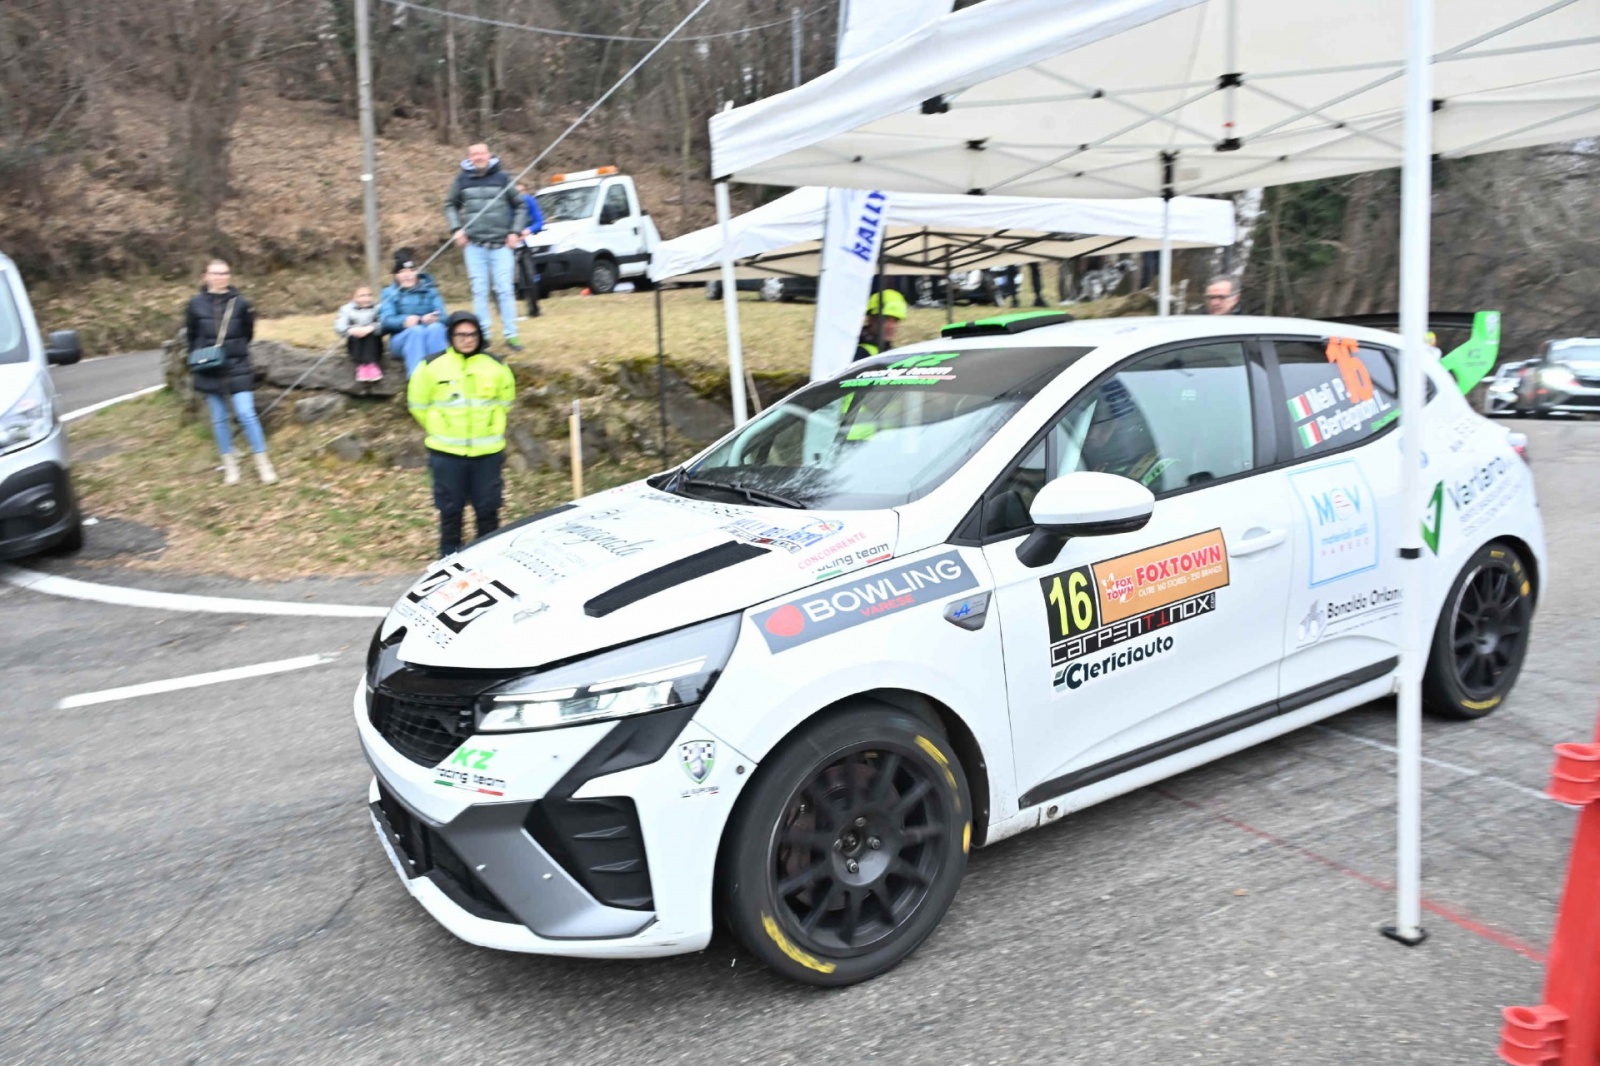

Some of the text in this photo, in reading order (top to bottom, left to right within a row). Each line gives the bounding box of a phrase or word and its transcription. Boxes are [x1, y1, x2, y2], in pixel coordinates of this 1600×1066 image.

[797, 531, 867, 570] CONCORRENTE
[856, 542, 890, 560] team
[1135, 544, 1223, 587] FOXTOWN
[802, 559, 962, 623] BOWLING
[1106, 587, 1135, 601] TOWN
[1115, 576, 1133, 590] FOX
[859, 593, 916, 618] VARESE
[1048, 571, 1093, 636] 16
[1065, 635, 1174, 690] Clericiauto
[450, 746, 496, 770] KZ
[473, 773, 507, 789] team
